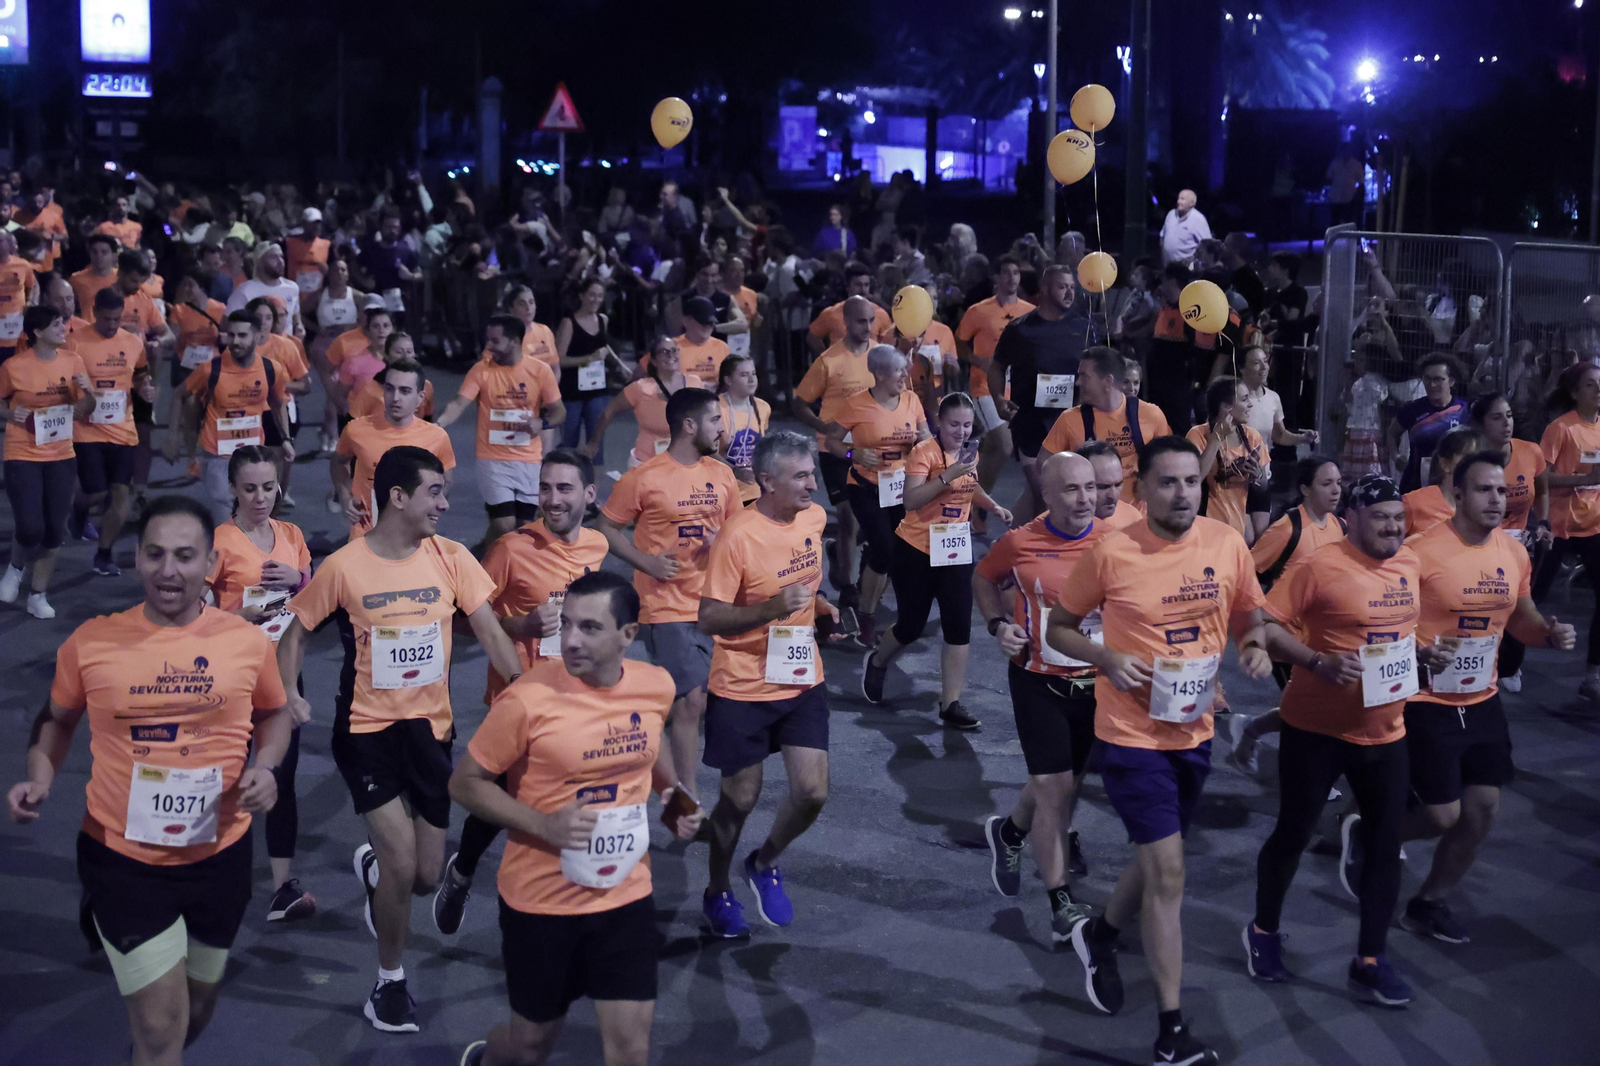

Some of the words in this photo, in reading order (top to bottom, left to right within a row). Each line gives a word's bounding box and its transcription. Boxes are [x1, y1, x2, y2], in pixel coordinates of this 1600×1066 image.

[87, 74, 147, 92] 22:04
[1066, 137, 1085, 147] KH7
[1045, 386, 1068, 395] 10252
[43, 417, 66, 429] 20190
[677, 499, 704, 507] SEVILLA
[941, 536, 966, 548] 13576
[790, 550, 817, 565] NOCTURNA
[777, 562, 806, 578] SEVILLA
[805, 556, 818, 568] KH7
[1179, 582, 1220, 593] NOCTURNA
[1478, 580, 1510, 588] NOCTURNA
[1161, 592, 1200, 604] SEVILLA
[1200, 590, 1219, 600] KH7
[1383, 591, 1414, 599] NOCTURNA
[1462, 587, 1493, 595] SEVILLA
[1368, 600, 1399, 608] SEVILLA
[1399, 598, 1414, 606] KH7
[390, 644, 434, 663] 10322
[787, 645, 812, 660] 3591
[1379, 658, 1412, 679] 10290
[1454, 656, 1485, 670] 3551
[156, 675, 214, 684] NOCTURNA
[128, 685, 181, 695] SEVILLA
[183, 684, 213, 694] KH7
[603, 731, 648, 746] NOCTURNA
[582, 746, 625, 760] SEVILLA
[626, 740, 648, 753] KH7
[152, 793, 206, 814] 10371
